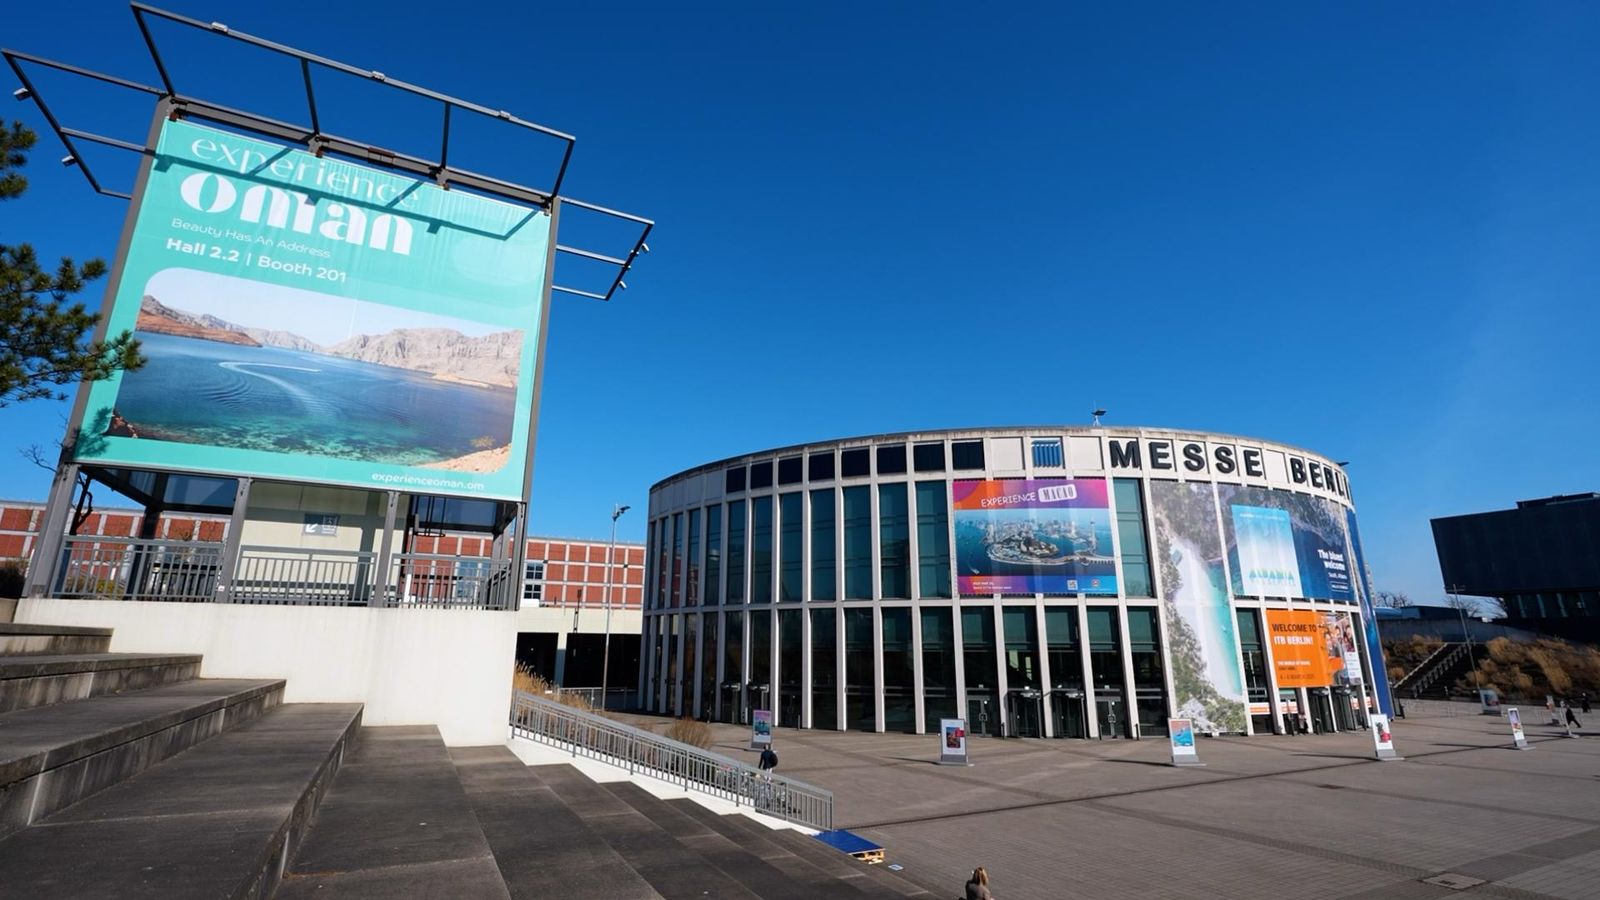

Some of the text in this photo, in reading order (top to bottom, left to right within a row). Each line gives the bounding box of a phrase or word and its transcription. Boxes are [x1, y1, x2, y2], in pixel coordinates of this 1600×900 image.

[191, 138, 419, 209] experience
[180, 171, 414, 256] oman
[171, 217, 331, 258] Beauty Has An Address
[166, 237, 206, 256] Hall
[209, 246, 240, 262] 2.2
[257, 254, 313, 277] Booth
[316, 266, 347, 283] 201
[371, 471, 485, 491] experienceoman.om
[1108, 439, 1350, 501] MESSE BERLI
[980, 485, 1075, 508] EXPERIENCE MACAO
[1317, 549, 1329, 560] The
[1271, 623, 1317, 633] WELCOME TO
[1273, 635, 1314, 646] ITB BERLIN!
